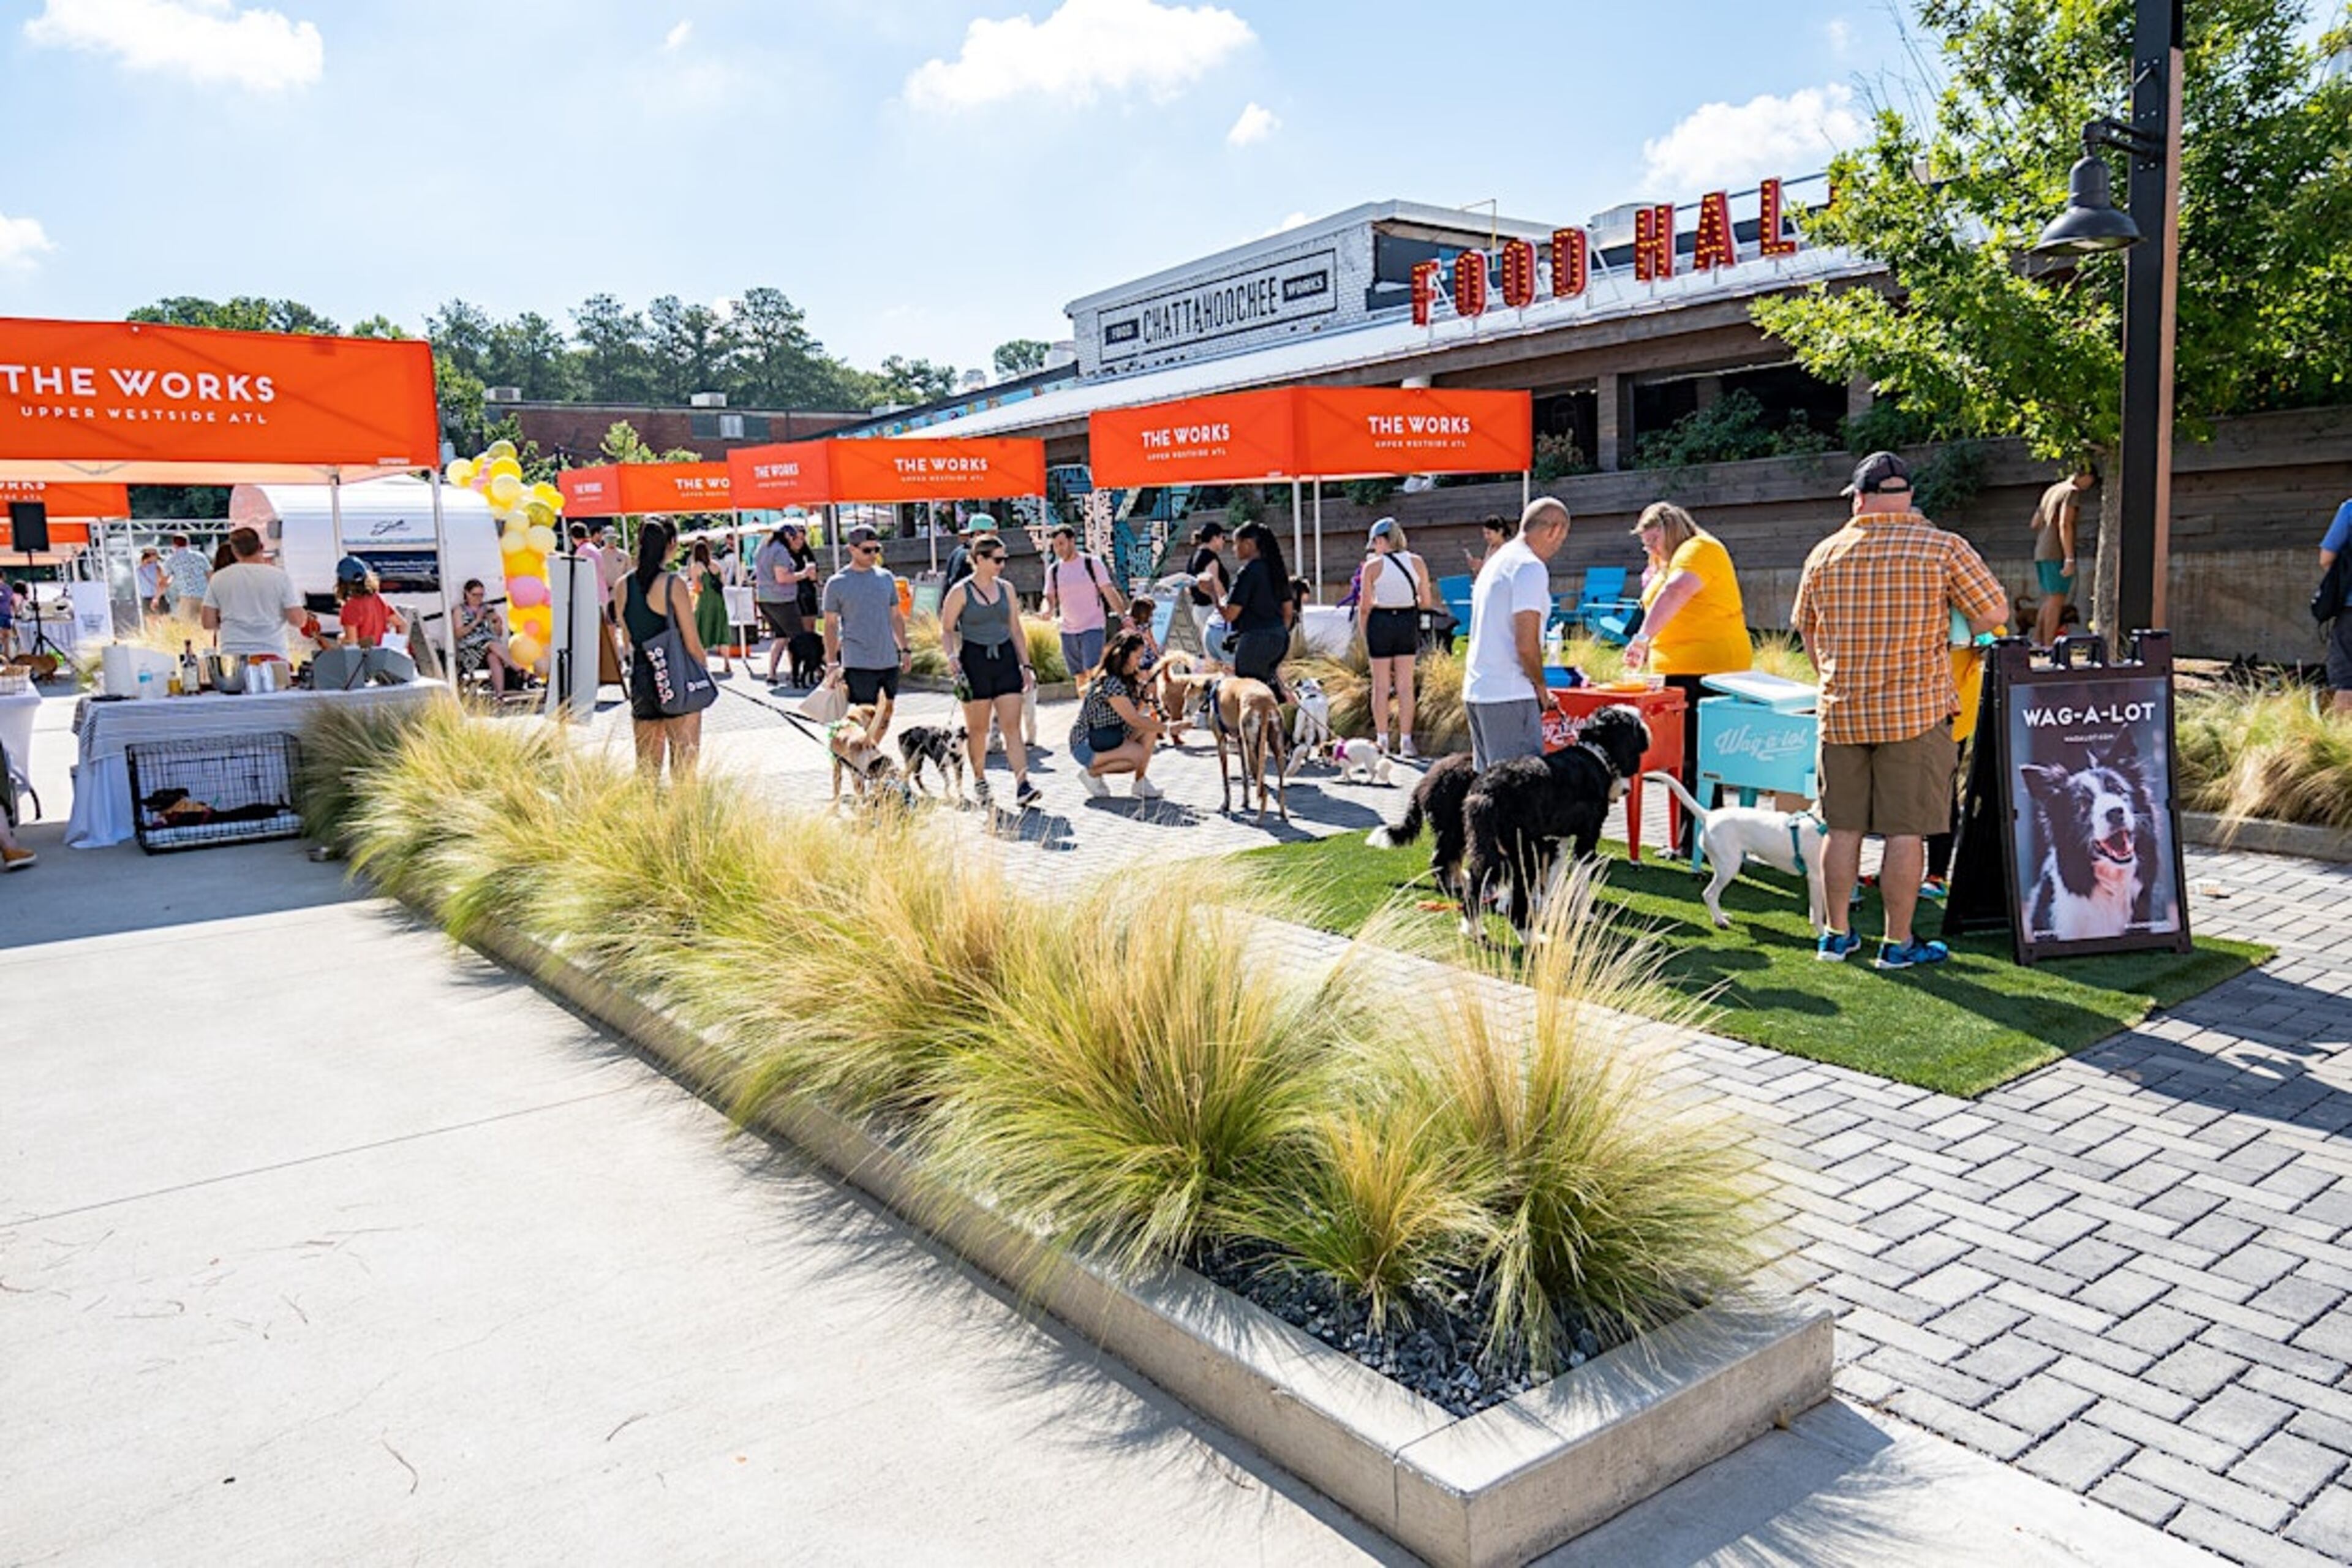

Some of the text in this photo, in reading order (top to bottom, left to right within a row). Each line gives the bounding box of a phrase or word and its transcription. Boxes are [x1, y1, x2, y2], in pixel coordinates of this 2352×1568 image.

[1412, 176, 1839, 326] FOOD HAL
[1143, 276, 1277, 344] CHATTAHOOCHEE
[0, 364, 275, 402] THE WORKS
[21, 406, 267, 424] UPPER WESTSIDE ATL
[1367, 416, 1471, 435] THE WORKS
[1141, 423, 1230, 449] THE WORKS
[894, 458, 988, 472] THE WORKS
[675, 477, 730, 490] THE WO
[2022, 702, 2156, 728] WAG-A-LOT
